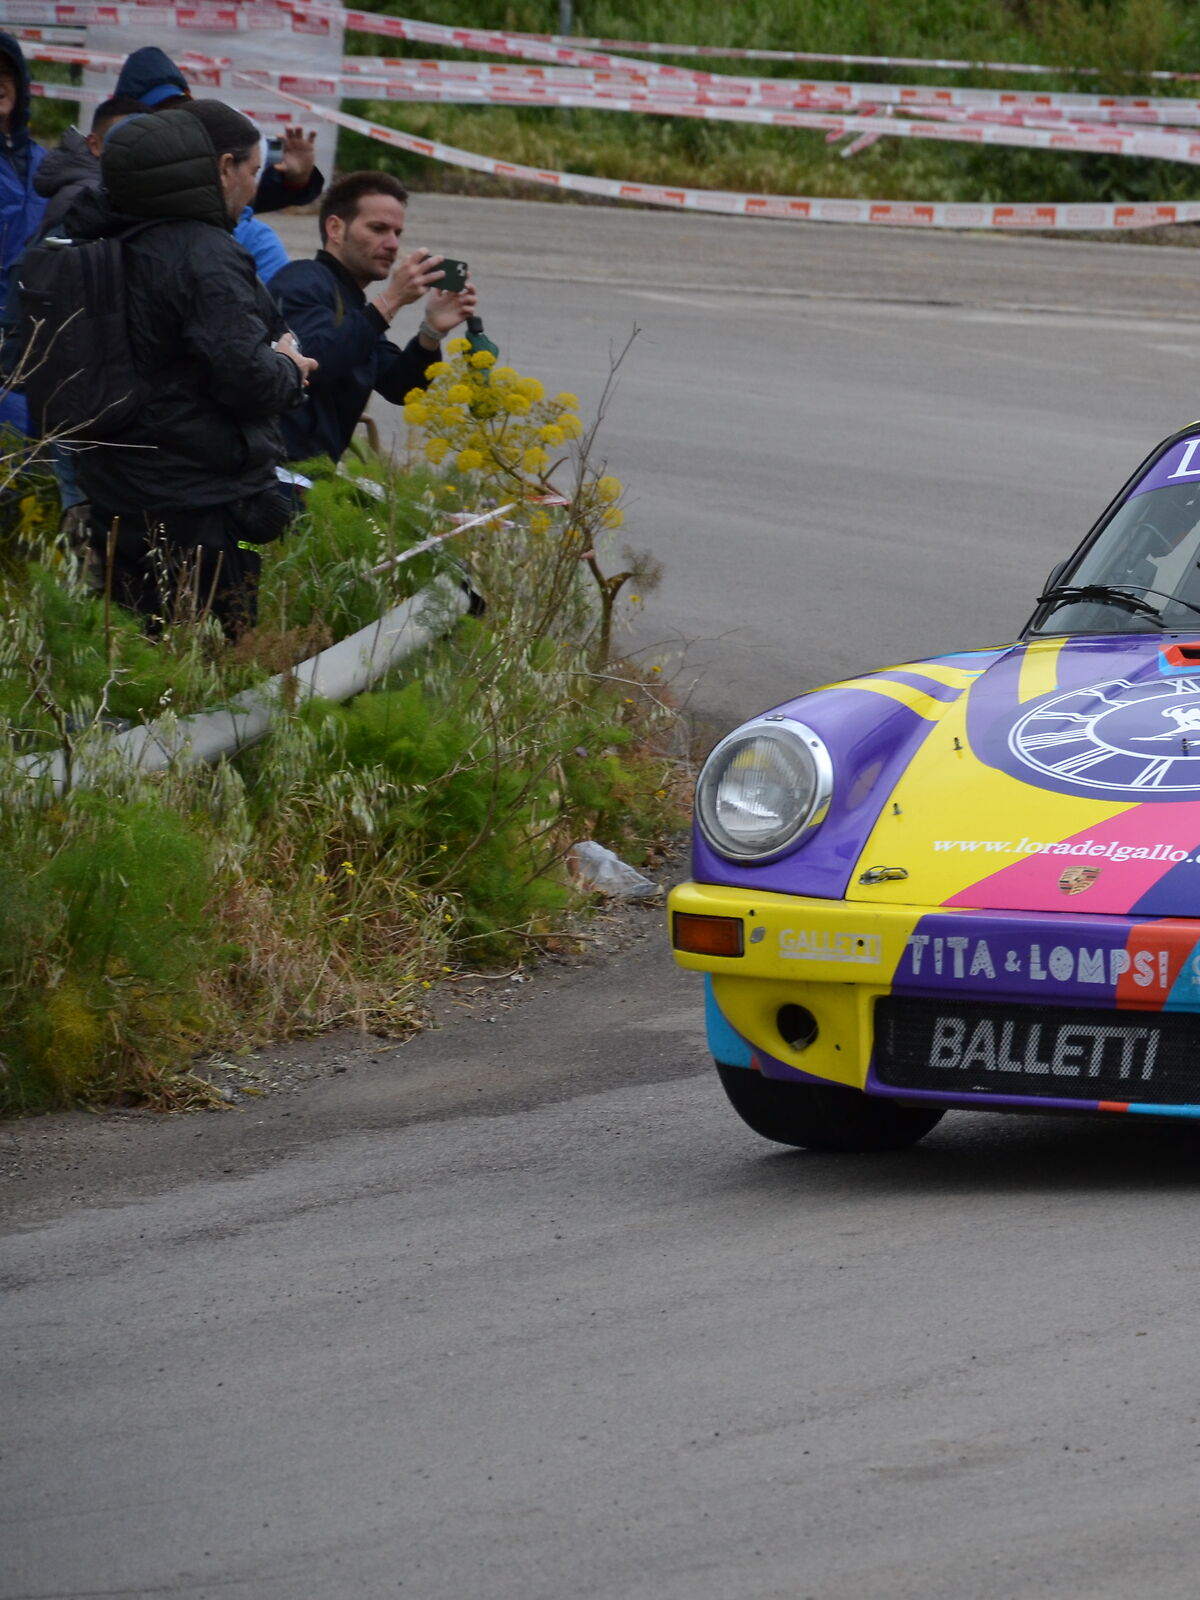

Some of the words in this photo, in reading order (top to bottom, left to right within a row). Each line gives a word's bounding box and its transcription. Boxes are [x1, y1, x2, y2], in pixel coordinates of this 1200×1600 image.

[778, 928, 882, 956] GALLETTI
[907, 935, 997, 979] TITA
[1004, 950, 1021, 972] &
[1029, 944, 1169, 989] LOMPSI
[929, 1016, 1161, 1080] BALLETTI
